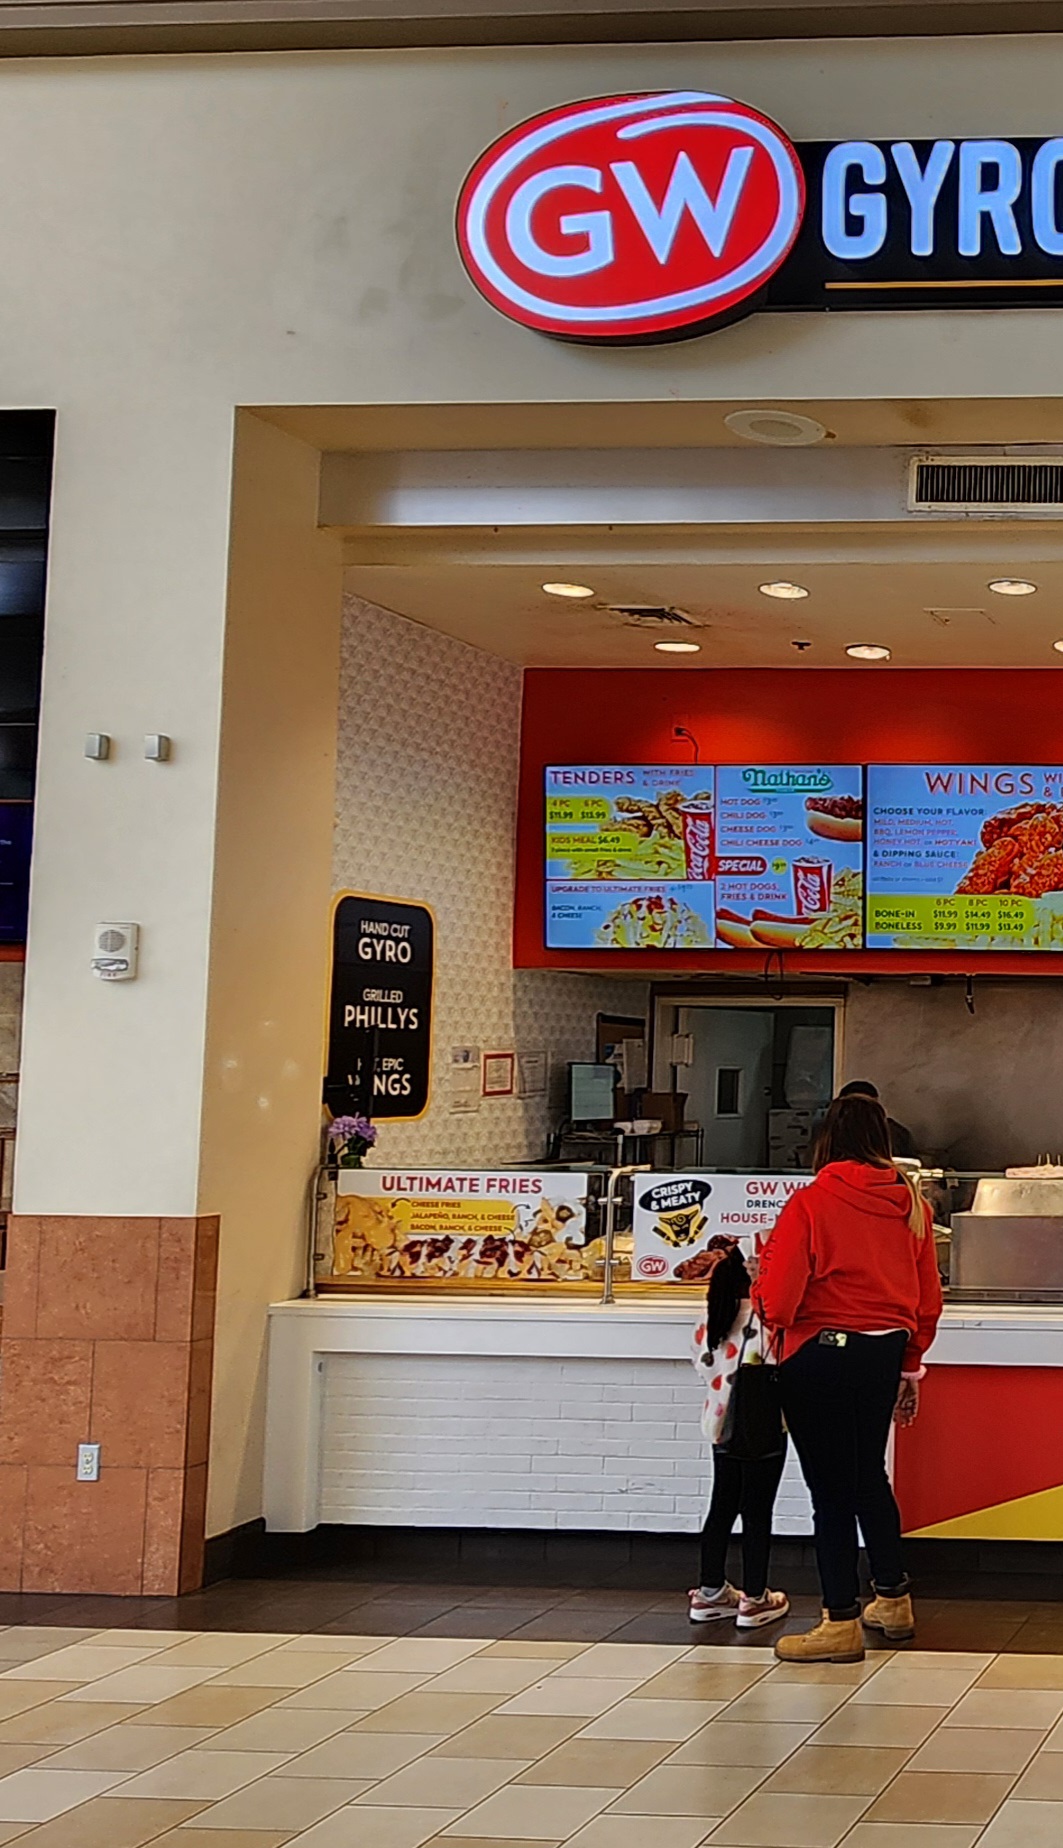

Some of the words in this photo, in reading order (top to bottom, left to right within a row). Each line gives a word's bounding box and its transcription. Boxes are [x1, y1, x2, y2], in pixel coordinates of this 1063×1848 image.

[505, 145, 755, 277] GW
[550, 770, 635, 785] TENDERS
[742, 768, 833, 787] Nathan's
[925, 771, 1035, 796] WINGS
[1043, 786, 1053, 798] &
[720, 798, 739, 806] HOT
[741, 798, 761, 806] DOG
[720, 812, 743, 820] CHILI
[746, 812, 767, 820] DOG
[873, 807, 914, 816] CHOOSE
[917, 808, 944, 816] YOUR
[551, 836, 571, 844] KIDS
[573, 836, 597, 844] MEAL
[873, 850, 879, 858] &
[881, 850, 922, 858] DIPPING
[717, 859, 765, 872] SPECIAL
[728, 883, 748, 891] HOT
[720, 893, 747, 901] FRIES
[757, 893, 788, 901] DRINK
[943, 898, 956, 907] PC
[975, 899, 988, 907] PC
[998, 899, 1008, 907] 10
[1009, 899, 1023, 907] PC
[874, 910, 916, 918] BONE-IN
[933, 910, 958, 919] $11.99
[964, 910, 992, 919] $14.49
[997, 911, 1024, 919] $16.49
[359, 919, 389, 937] HAND
[390, 923, 411, 938] CUT
[874, 922, 923, 931] BONELESS
[934, 922, 957, 931] $9.99
[965, 922, 991, 931] $11.99
[357, 937, 412, 964] GYRO
[362, 988, 404, 1004] GRILLED
[343, 1004, 420, 1030] PHILLYS
[381, 1057, 405, 1071] EPIC
[381, 1175, 481, 1195] ULTIMATE
[485, 1177, 543, 1195] FRIES
[745, 1181, 779, 1196] GW
[651, 1181, 695, 1200] CRISPY
[410, 1201, 440, 1209] CHEESE
[441, 1201, 462, 1209] FRIES
[650, 1200, 660, 1211] &
[660, 1191, 702, 1209] MEATY
[488, 1213, 516, 1222] CHEESE
[474, 1224, 503, 1233] CHEESE
[640, 1259, 665, 1272] GW
